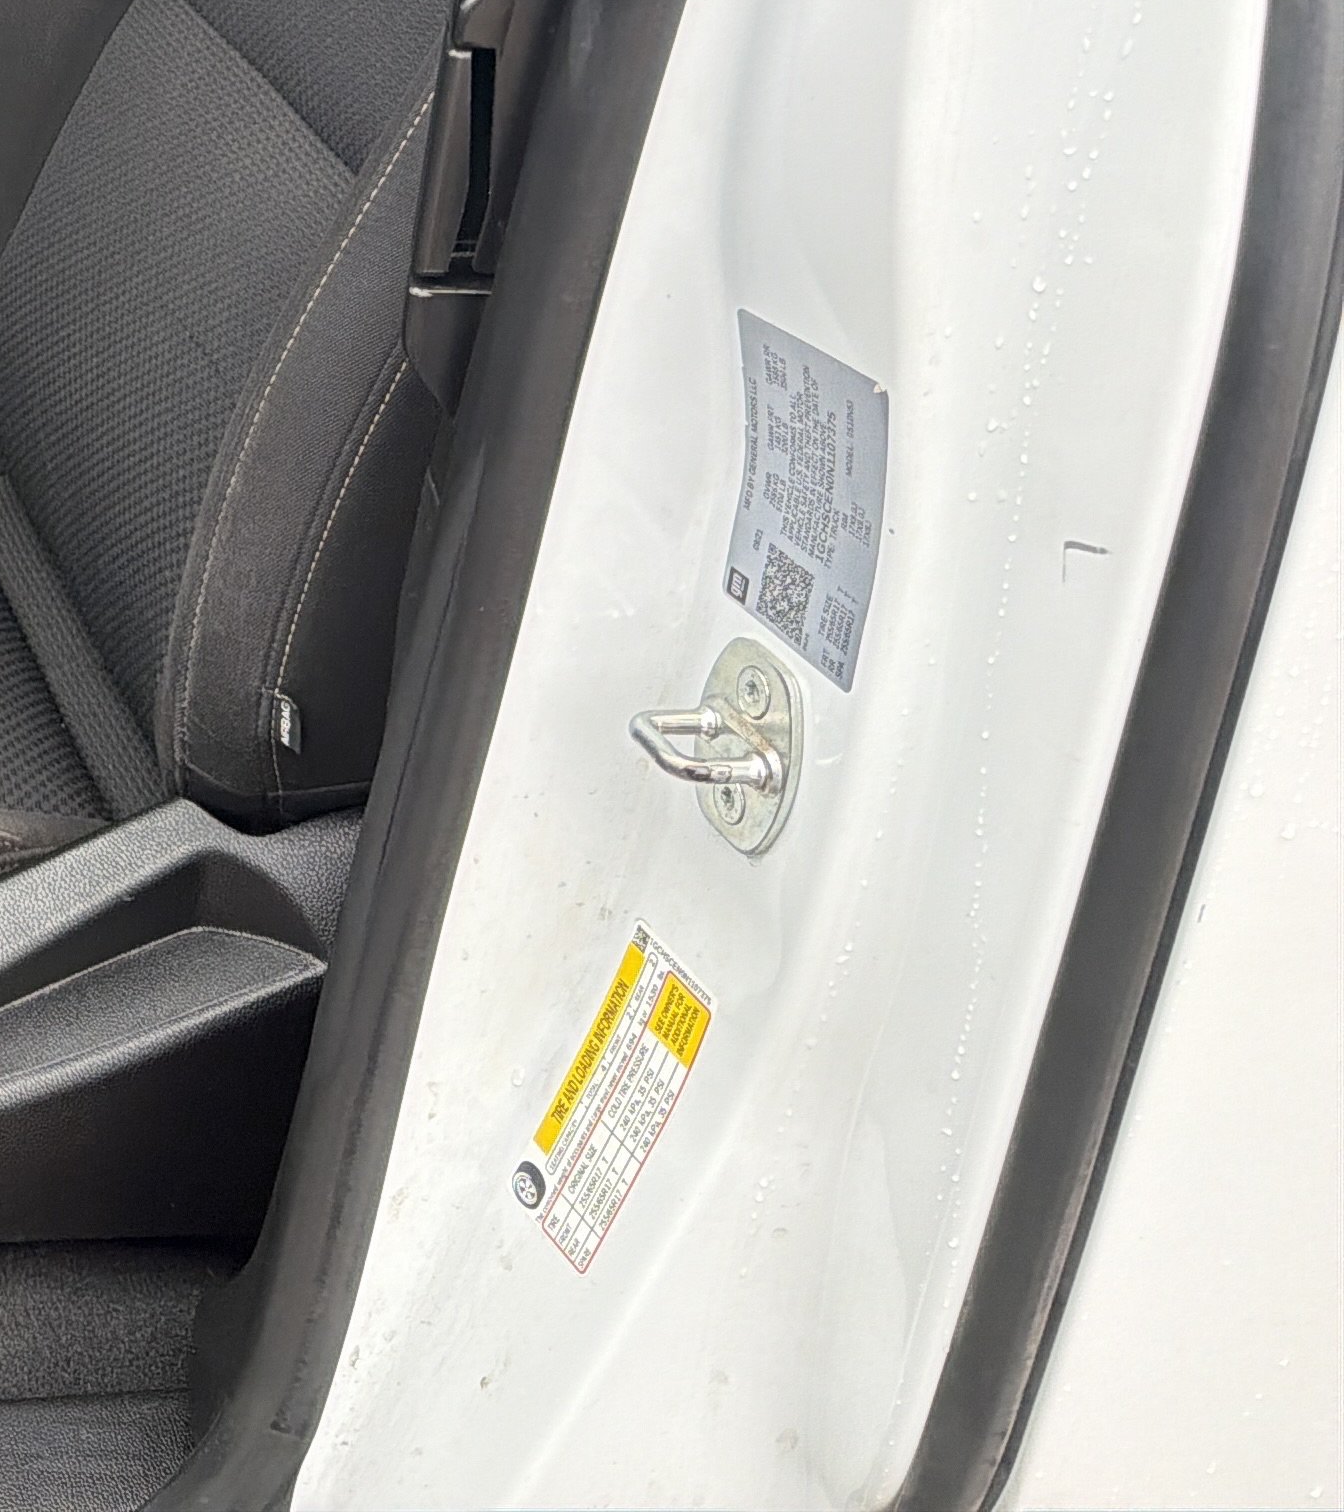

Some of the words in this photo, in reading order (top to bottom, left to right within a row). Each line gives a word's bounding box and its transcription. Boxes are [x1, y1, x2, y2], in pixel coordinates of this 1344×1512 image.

[748, 434, 757, 474] GENERAL
[784, 477, 794, 514] VEHICLE
[790, 411, 795, 423] TO
[787, 486, 800, 540] APPLICABLE
[801, 497, 815, 551] STANDARDS
[810, 452, 818, 485] EFFECT
[808, 490, 823, 557] MANUFACTURE
[829, 508, 840, 540] TRUCK
[794, 509, 805, 545] VEHICLE
[281, 700, 292, 746] AIRBAG
[655, 1017, 664, 1033] SEE
[663, 1010, 678, 1039] MANUAL
[675, 992, 684, 1009] FOR
[671, 1003, 691, 1045] ADDITIONAL
[676, 1006, 699, 1056] INFORMATION
[551, 1098, 568, 1124] TIRE
[562, 1078, 579, 1103] AND
[573, 1039, 600, 1083] LOADING
[593, 978, 628, 1043] INFORMATION
[608, 1096, 621, 1118] COLD
